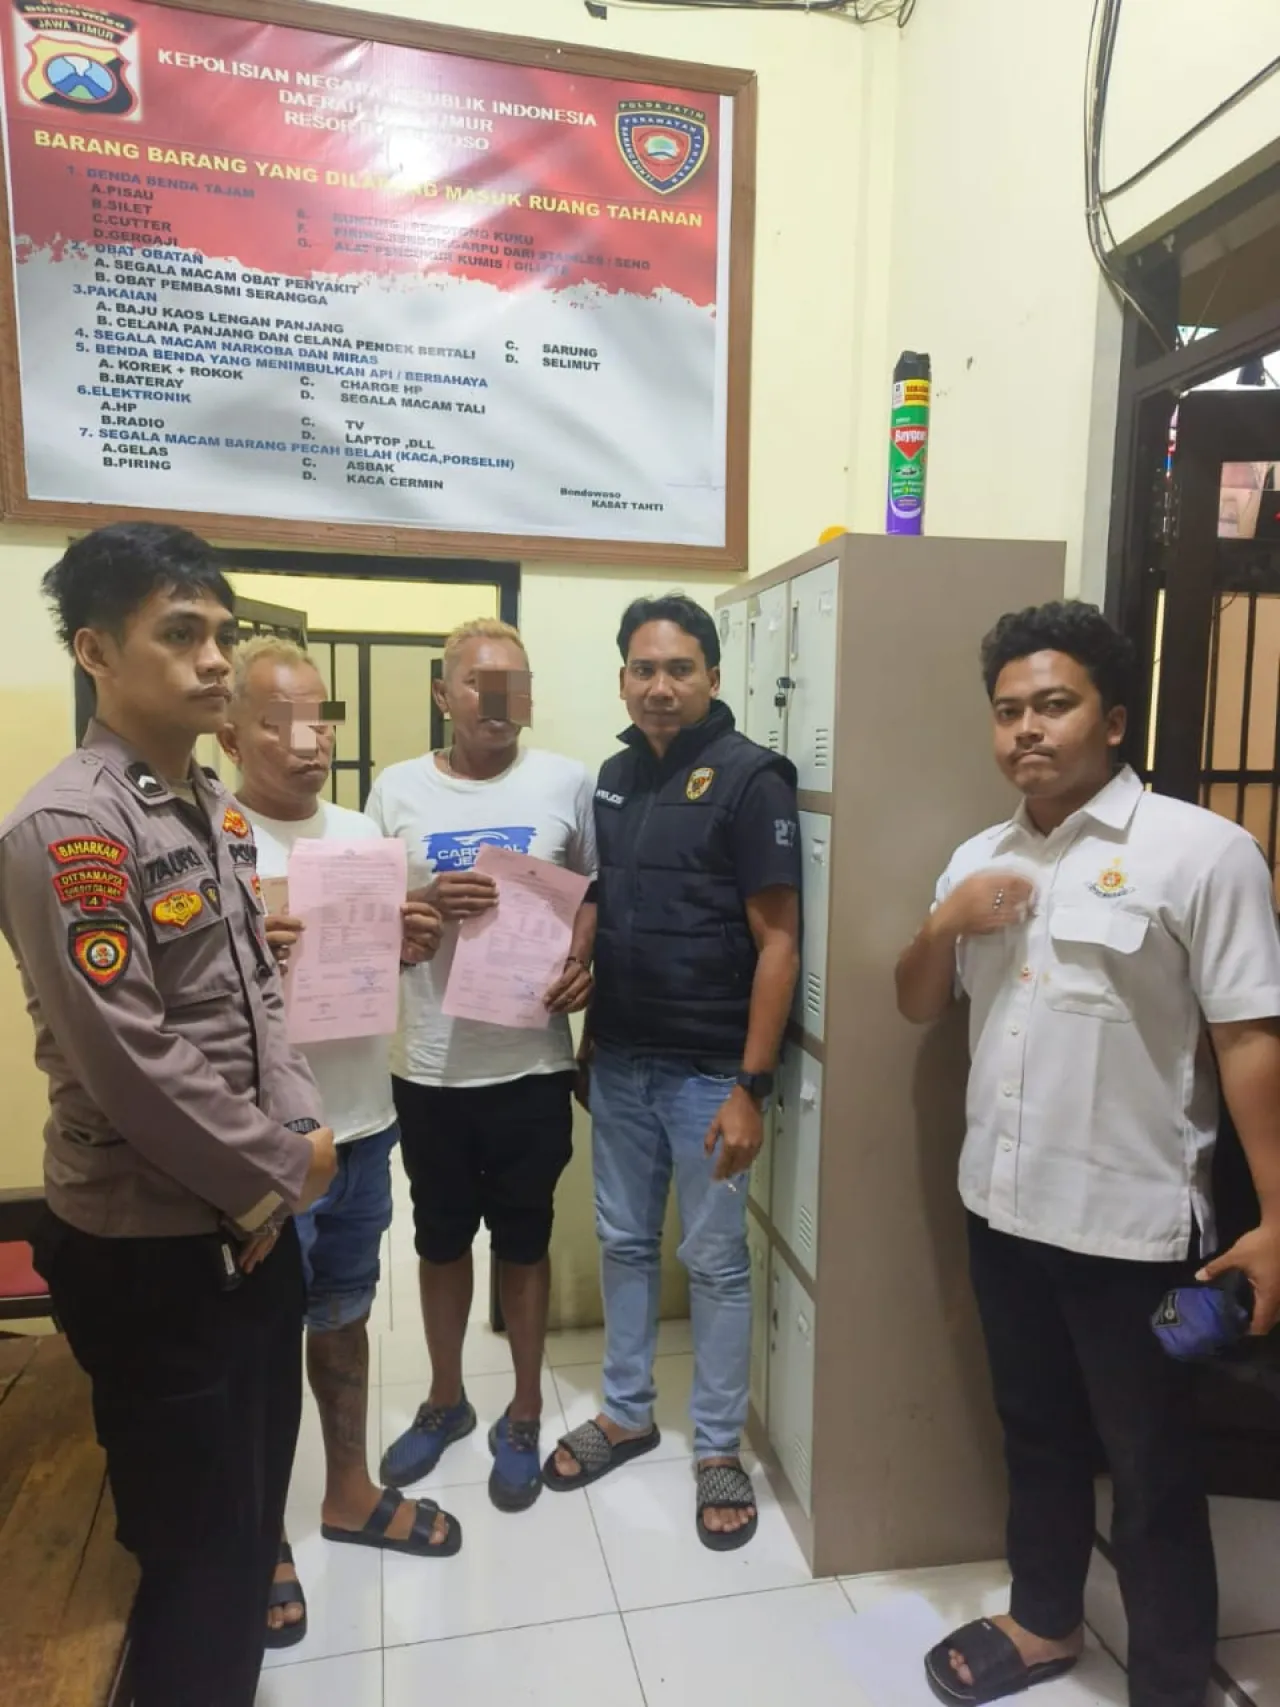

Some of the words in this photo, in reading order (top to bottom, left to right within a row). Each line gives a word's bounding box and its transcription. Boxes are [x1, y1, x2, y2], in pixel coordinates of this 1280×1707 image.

[157, 48, 290, 84] KEPOLISIAN
[491, 101, 597, 127] INDONESIA
[278, 89, 363, 114] DAERAH
[35, 130, 140, 159] BARANG
[147, 146, 247, 174] BARANG
[255, 161, 318, 184] YANG
[325, 170, 438, 198] DILARG
[446, 186, 522, 208] MASUK
[529, 195, 601, 217] RUANG
[607, 204, 702, 227] TAHANAN
[87, 168, 141, 185] BENDA
[146, 174, 198, 192] BENDA
[204, 183, 255, 198] TAJAM
[91, 183, 153, 201] A.PISAU
[91, 198, 152, 214] B.SILET
[93, 213, 172, 233] C.CUTTER
[93, 228, 179, 247] D.GERGAJI
[493, 231, 533, 246] KUKU
[95, 243, 136, 257] OBAT
[142, 247, 203, 265] OBATAN
[458, 255, 502, 270] KUMIS
[503, 245, 535, 259] DARI
[615, 257, 650, 270] SENG
[95, 258, 109, 269] A.
[114, 259, 177, 277] SEGALA
[181, 265, 237, 282] MACAM
[241, 272, 281, 288] OBAT
[286, 278, 360, 295] PENYAKIT
[73, 283, 157, 302] 3.PAKAIAN
[95, 271, 110, 283] B.
[115, 273, 156, 288] OBAT
[161, 278, 241, 297] PEMBASMI
[246, 287, 328, 306] SERANGGA
[96, 301, 112, 313] A.
[115, 302, 157, 318] BAJU
[162, 306, 205, 322] KAOS
[209, 311, 270, 329] LENGAN
[275, 318, 345, 335] PANJANG
[75, 327, 89, 340] 4.
[94, 328, 157, 346] SEGALA
[161, 334, 217, 351] MACAM
[222, 340, 293, 358] NARKOBA
[298, 347, 328, 362] DAN
[333, 351, 378, 366] MIRAS
[97, 315, 113, 327] B.
[116, 317, 179, 334] CELANA
[183, 323, 254, 341] PANJANG
[259, 329, 289, 344] DAN
[294, 333, 352, 350] CELANA
[356, 339, 414, 355] PENDEK
[418, 345, 476, 360] BERTALI
[505, 340, 519, 351] C.
[542, 343, 598, 359] SARUNG
[76, 342, 90, 354] 5.
[95, 343, 147, 359] BENDA
[153, 347, 206, 364] BENDA
[210, 352, 252, 368] YANG
[256, 357, 365, 378] MENIMBULKAN
[370, 368, 393, 381] API
[405, 371, 489, 389] BERBAHAYA
[99, 357, 115, 370] A.
[118, 359, 172, 375] KOREK
[176, 365, 185, 375] +
[190, 364, 244, 381] ROKOK
[505, 353, 519, 365] D.
[542, 357, 601, 372] SELIMUT
[99, 372, 185, 390] B.BATERAY
[300, 375, 315, 388] C.
[340, 379, 399, 393] CHARGE
[403, 384, 423, 395] HP
[77, 384, 192, 404] 6.ELEKTRONIK
[300, 389, 315, 401] D.
[340, 392, 397, 407] SEGALA
[401, 397, 452, 411] MACAM
[456, 402, 485, 415] TALI
[100, 401, 138, 414] A.HP
[101, 414, 165, 430] B.RADIO
[301, 416, 315, 428] C.
[345, 419, 365, 431] TV
[79, 427, 94, 439] 7.
[98, 428, 160, 445] SEGALA
[164, 432, 221, 447] MACAM
[225, 438, 286, 453] BARANG
[291, 442, 340, 457] PECAH
[344, 447, 392, 461] BELAH
[301, 429, 315, 441] D.
[345, 433, 401, 447] LAPTOP
[102, 442, 169, 458] A.GELAS
[103, 456, 172, 472] B.PIRING
[302, 457, 317, 469] C.
[346, 460, 395, 473] ASBAK
[302, 470, 317, 482] D.
[346, 474, 385, 487] KACA
[389, 476, 444, 490] CERMIN
[560, 487, 621, 499] Bondowoso
[58, 840, 121, 861] BAHARKAM
[437, 843, 523, 860] CARDAL
